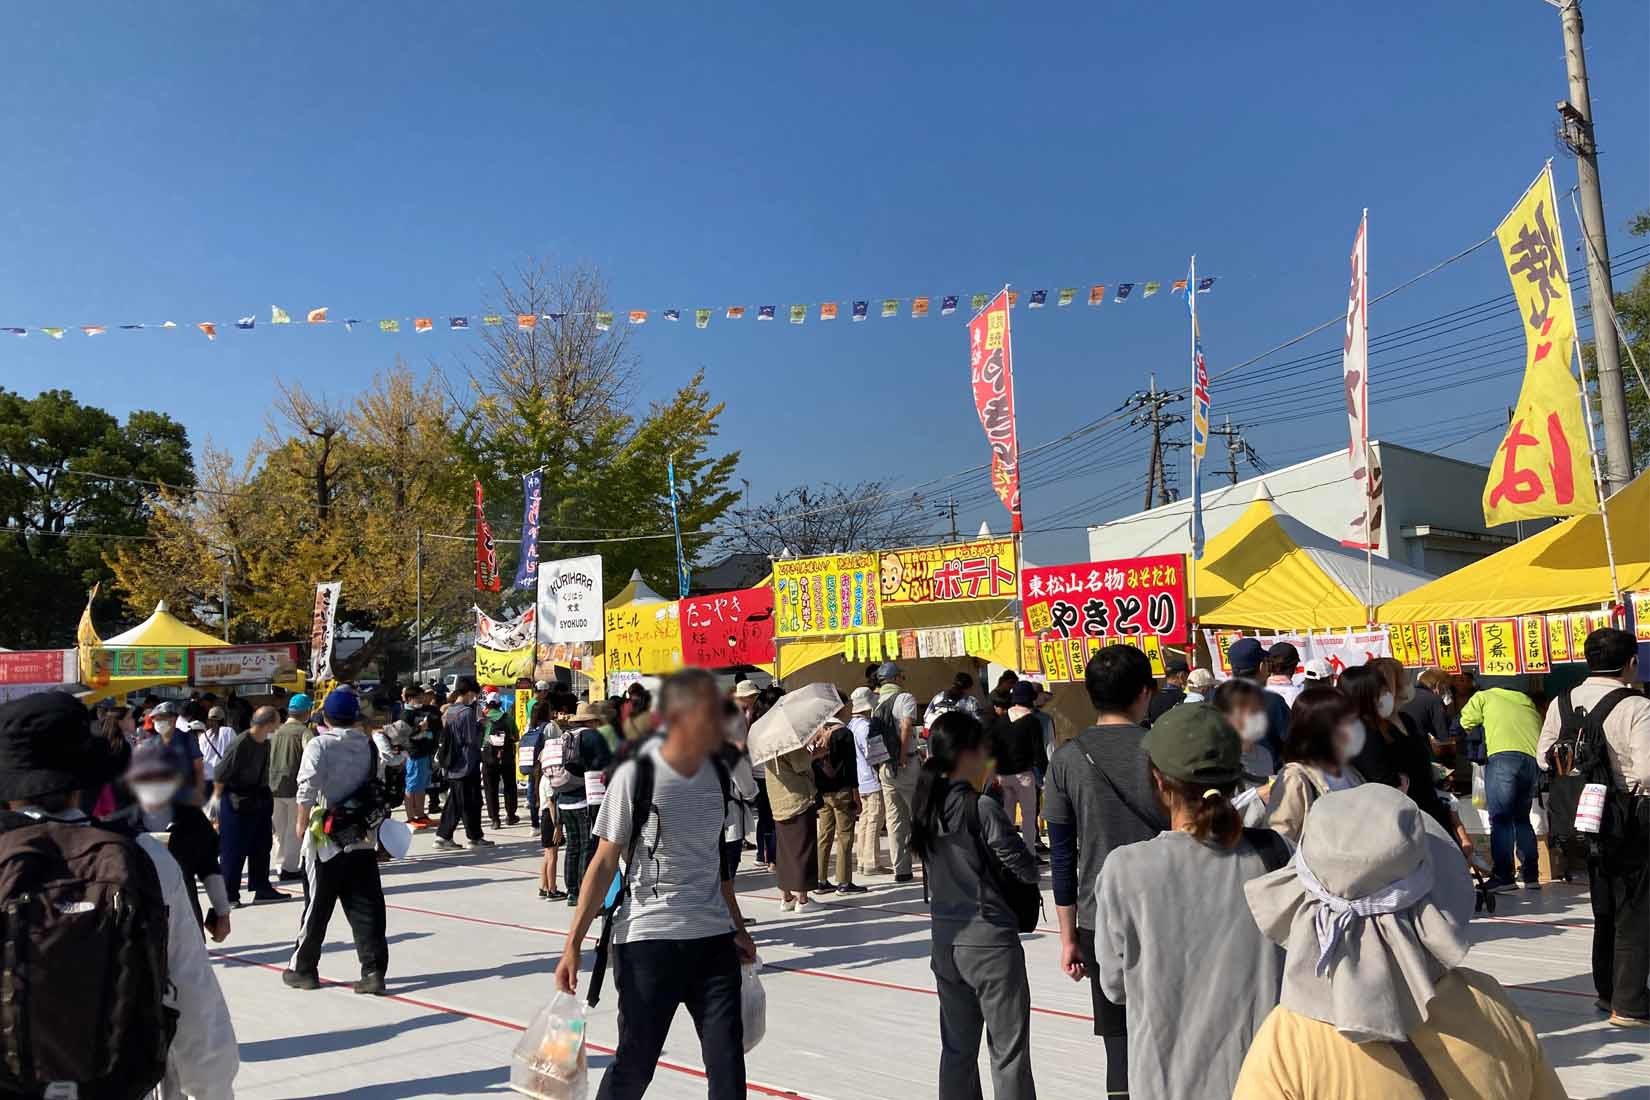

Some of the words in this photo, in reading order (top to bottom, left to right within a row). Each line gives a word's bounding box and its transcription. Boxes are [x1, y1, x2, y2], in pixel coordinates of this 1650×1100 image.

[551, 572, 593, 594] KURIHARA
[933, 556, 1015, 600] ポテト
[1027, 568, 1125, 599] 東松山名物
[1127, 565, 1176, 589] みそだれ
[563, 592, 583, 601] くりはら
[687, 596, 741, 627] たこやき
[560, 619, 587, 629] SYOKUDO
[608, 611, 640, 632] 生ビール
[1051, 592, 1176, 638] やきとり
[1404, 625, 1413, 649] メンチ
[1418, 626, 1429, 652] ラーメン
[1438, 624, 1451, 657] 唐揚げ
[1484, 624, 1508, 658] もつ煮
[1527, 620, 1540, 658] 焼きそば
[1043, 643, 1057, 676] かしら
[1071, 640, 1085, 674] ねぎま
[1147, 649, 1159, 661] 皮
[1487, 662, 1514, 672] 450
